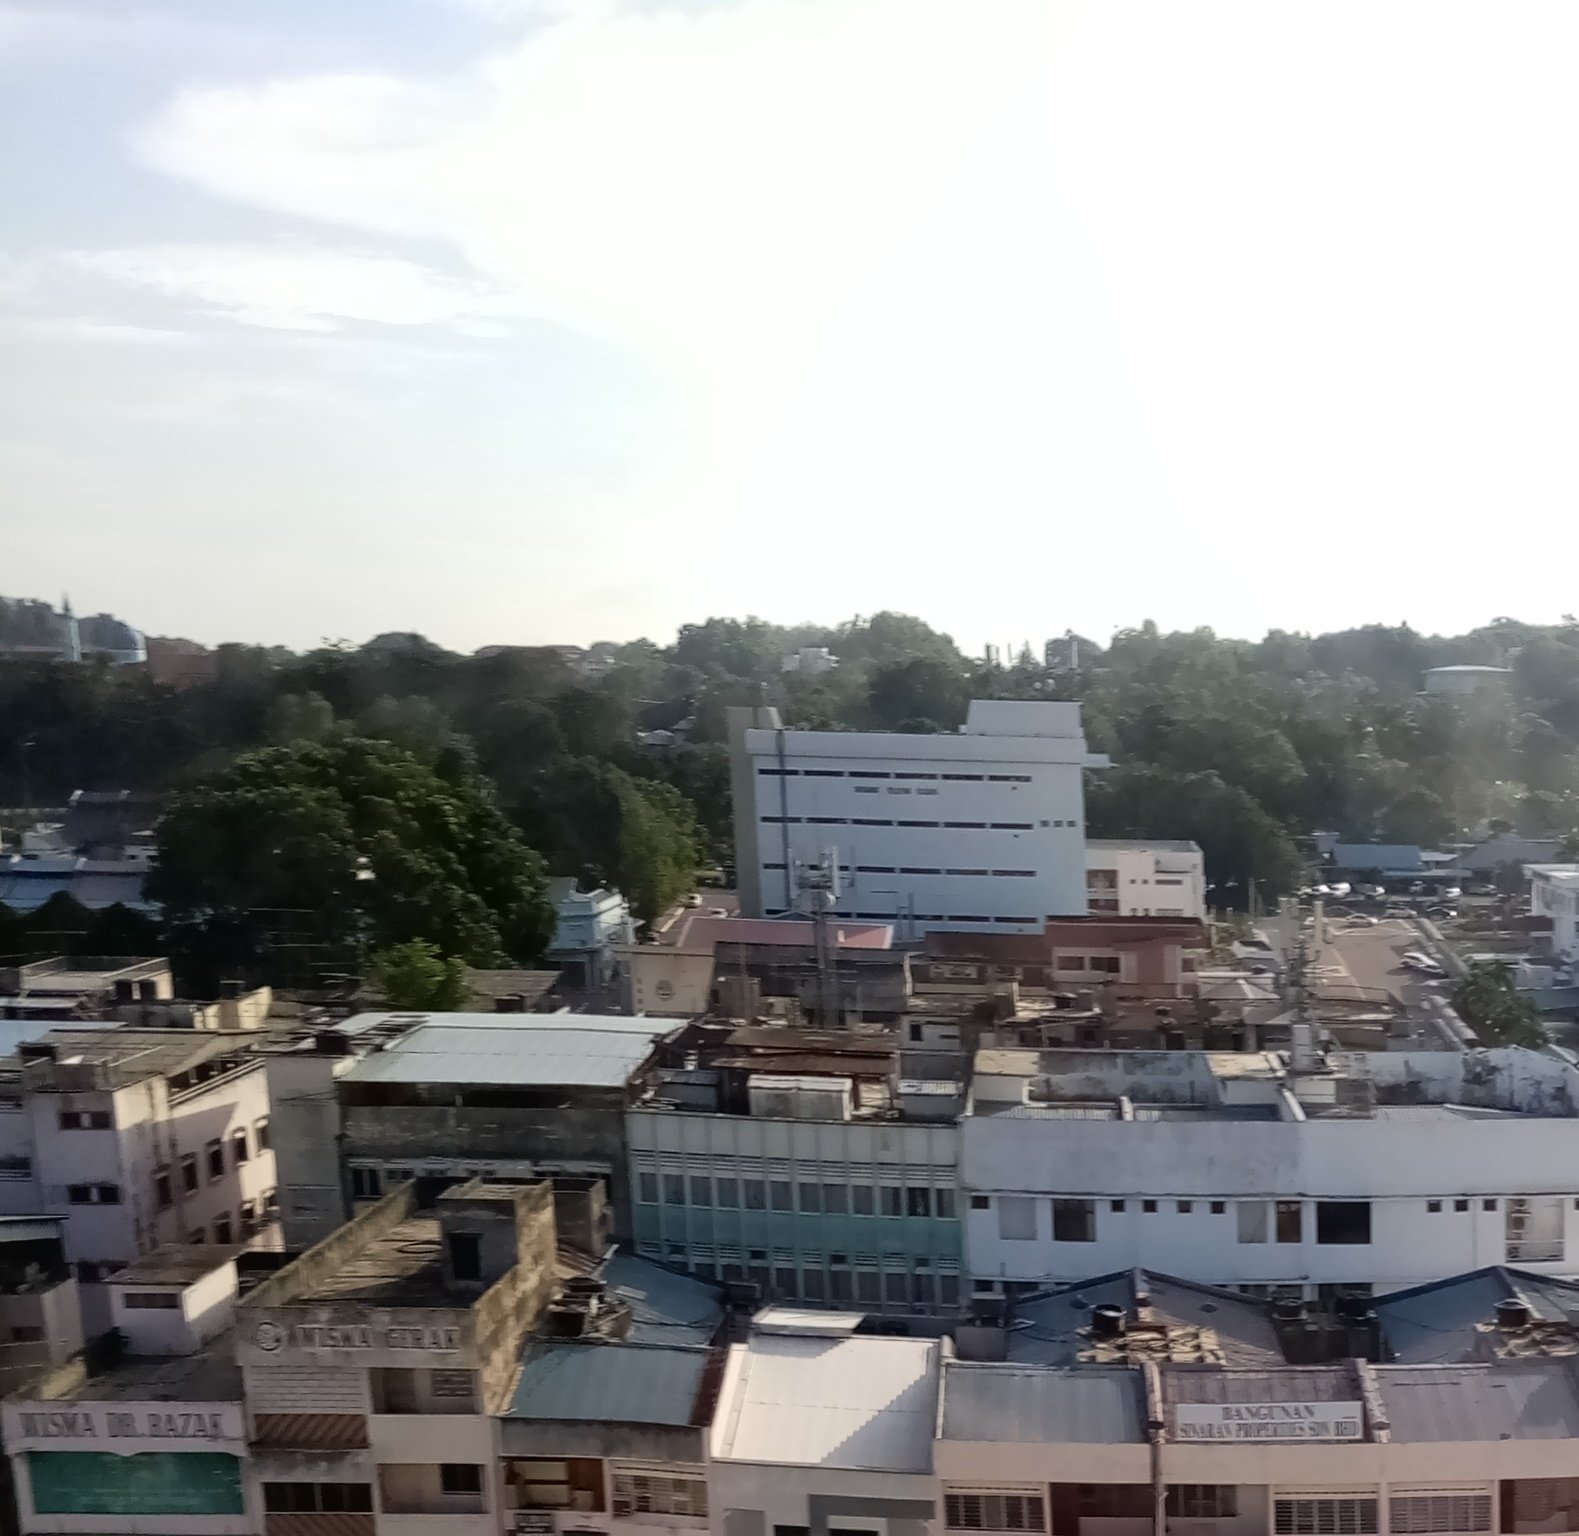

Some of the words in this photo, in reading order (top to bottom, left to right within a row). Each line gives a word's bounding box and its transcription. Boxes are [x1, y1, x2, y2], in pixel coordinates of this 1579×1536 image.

[1222, 1405, 1316, 1421] BANGUNAN
[19, 1412, 97, 1438] WISMA
[147, 1412, 223, 1439] RAZAK
